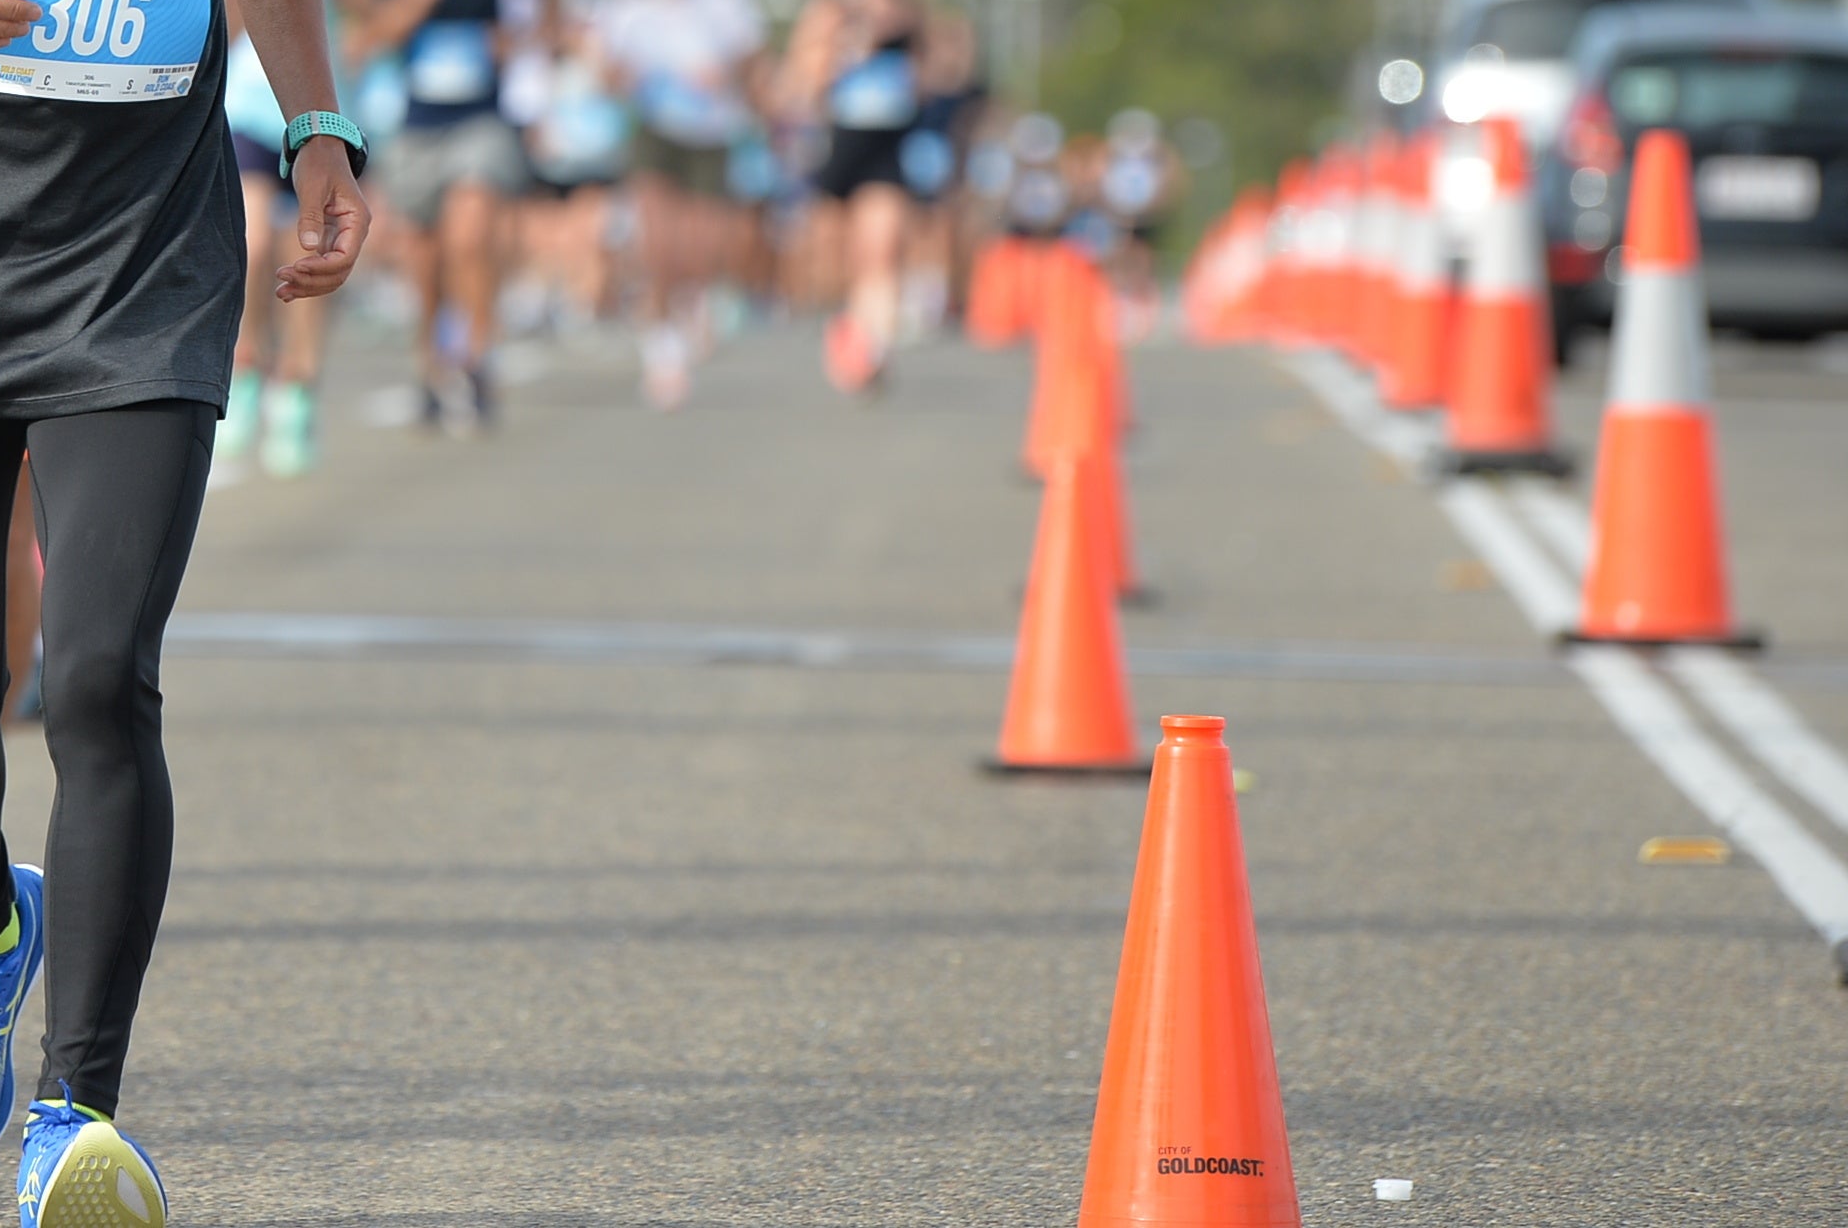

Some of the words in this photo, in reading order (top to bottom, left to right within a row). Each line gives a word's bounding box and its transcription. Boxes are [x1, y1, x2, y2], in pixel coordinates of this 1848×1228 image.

[0, 73, 33, 84] MARATHON
[43, 75, 51, 86] C
[126, 79, 134, 90] S
[1158, 1146, 1178, 1155] CITY
[1180, 1146, 1192, 1155] OF
